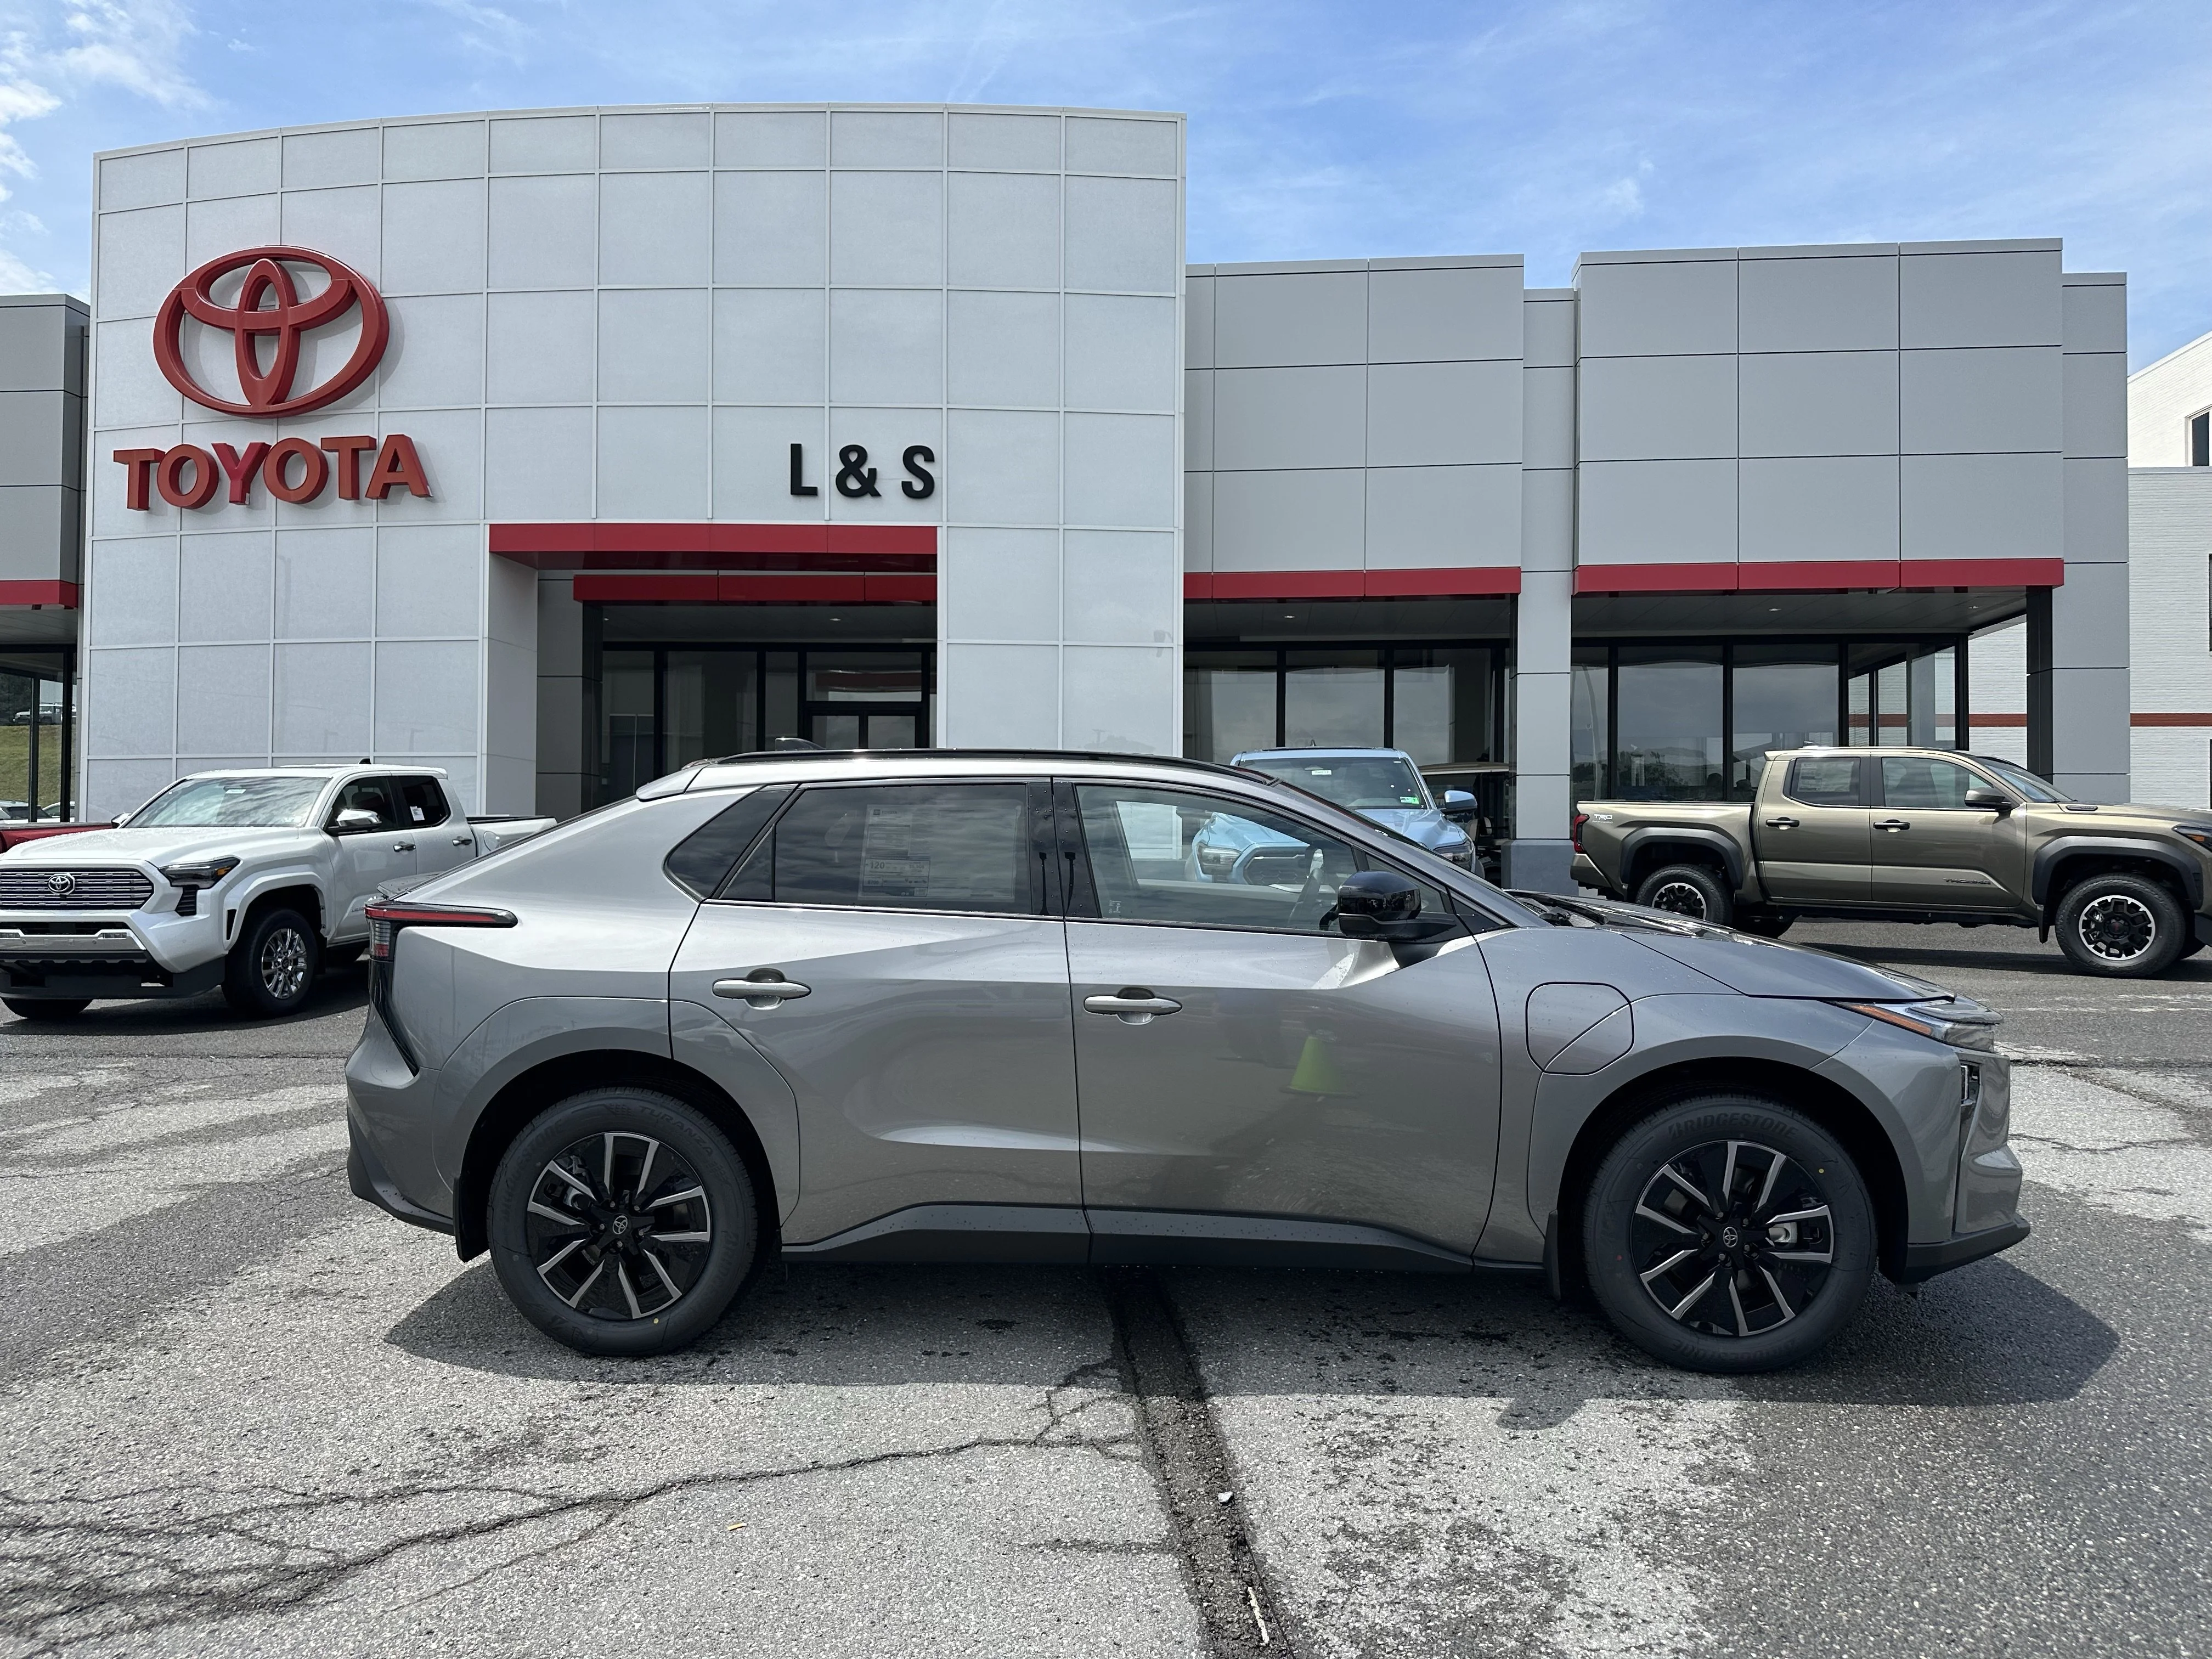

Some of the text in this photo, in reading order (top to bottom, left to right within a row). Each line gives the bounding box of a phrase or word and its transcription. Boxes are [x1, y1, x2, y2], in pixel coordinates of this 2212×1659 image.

[113, 434, 433, 511] TOYOTA
[790, 443, 935, 499] L & S
[638, 1105, 714, 1156] TURANZA
[1667, 1112, 1799, 1140] BRIDGESTONE
